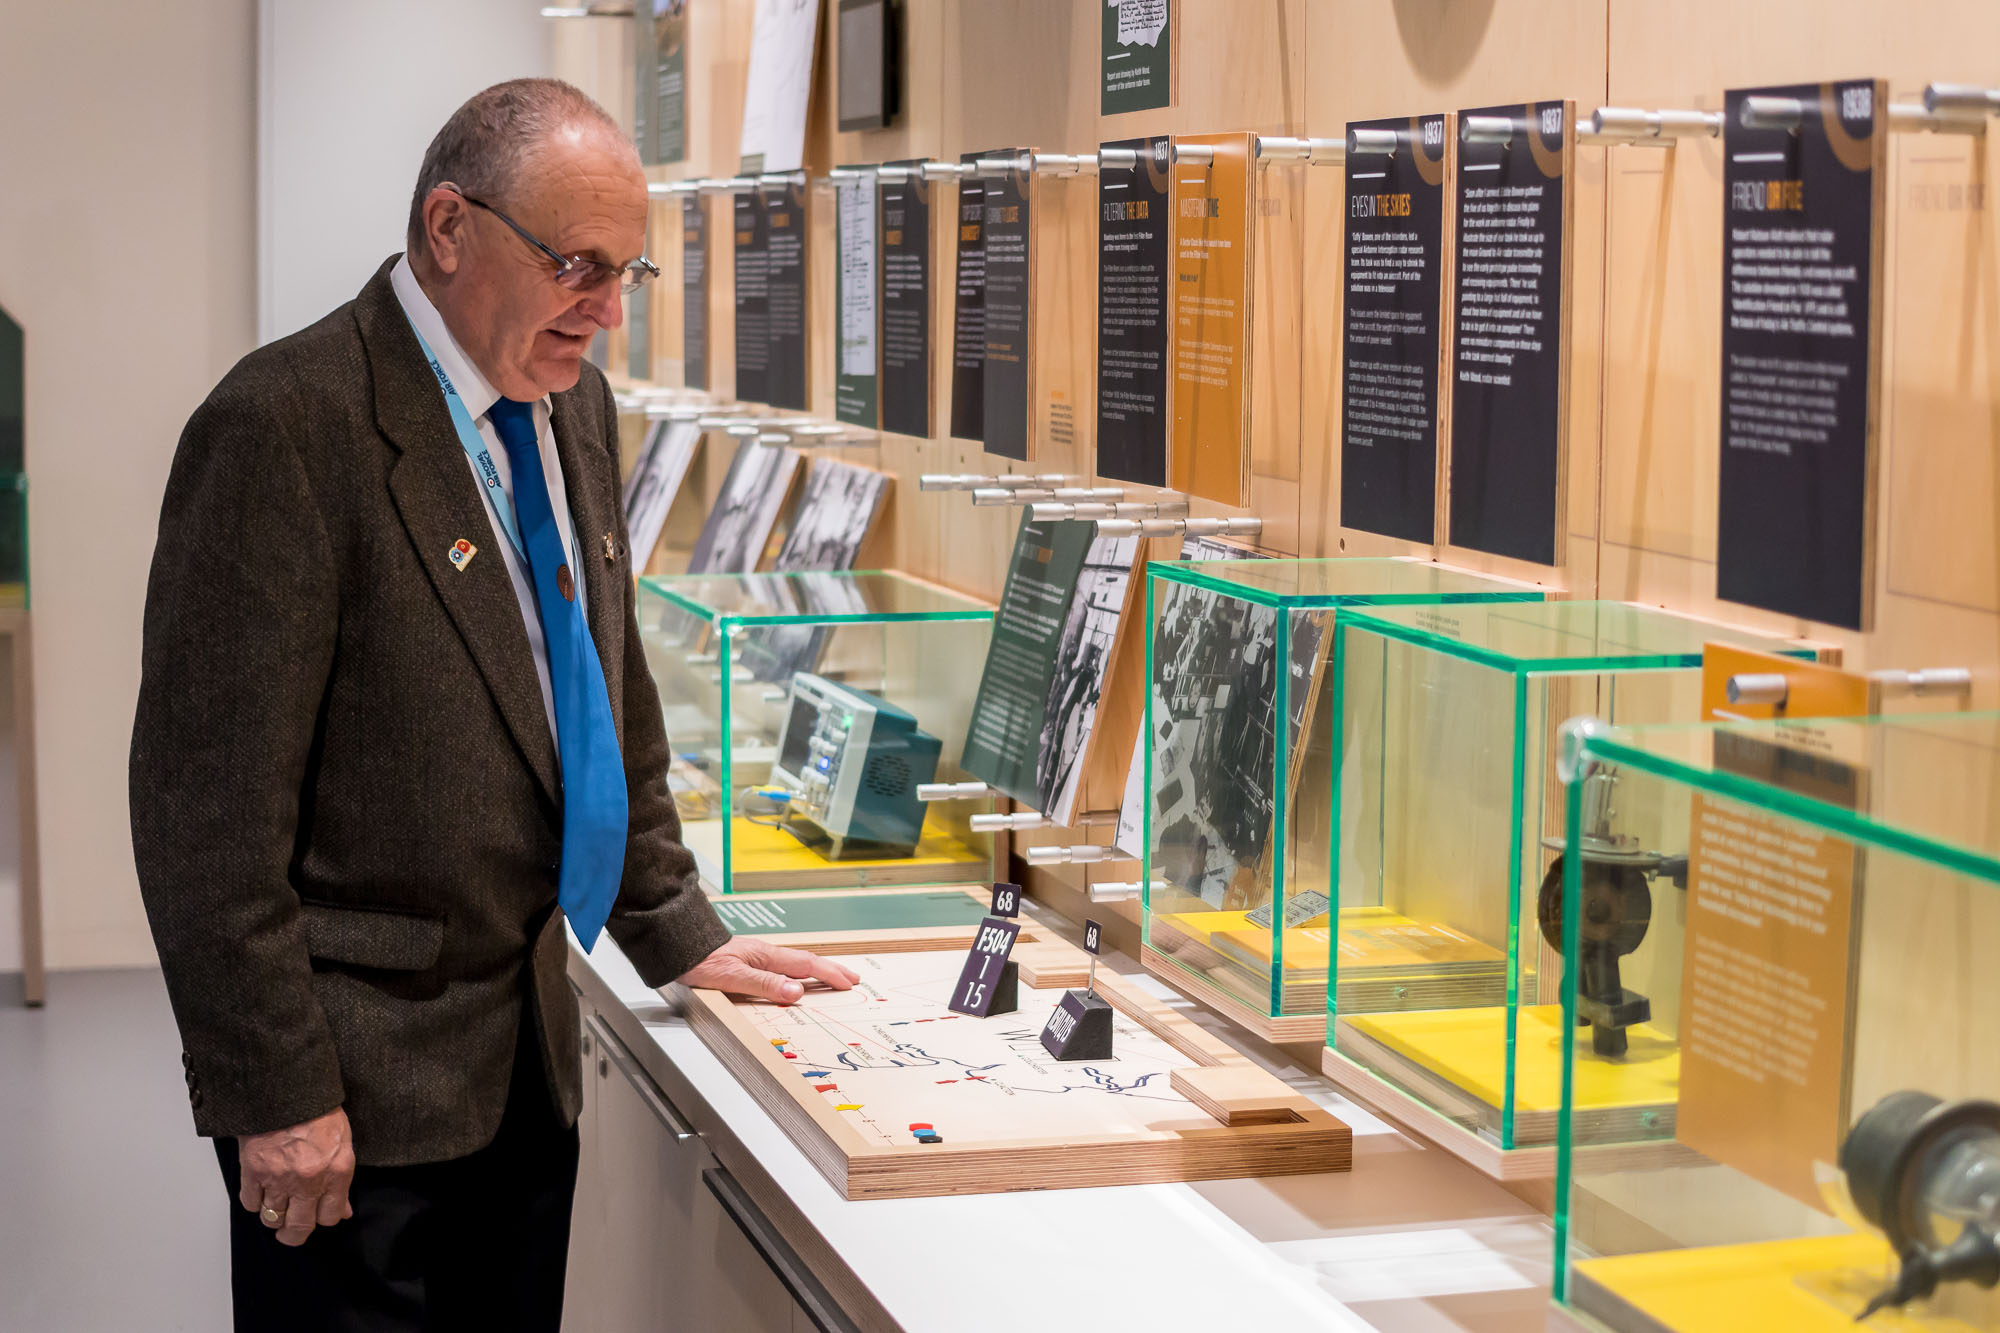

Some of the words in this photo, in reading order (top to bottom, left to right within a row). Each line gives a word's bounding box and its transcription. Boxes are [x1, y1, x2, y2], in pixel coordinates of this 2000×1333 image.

[1424, 121, 1444, 145] 1937
[1542, 108, 1563, 134] 1937
[1155, 142, 1168, 161] 1937
[1104, 202, 1126, 221] FILTERING
[1126, 201, 1136, 220] THE
[1136, 200, 1149, 220] DATA
[1352, 195, 1369, 218] EYES
[1369, 195, 1376, 217] IN
[1376, 194, 1390, 216] THE
[1390, 193, 1412, 216] SKIES
[431, 360, 448, 383] FORCE
[445, 383, 457, 395] AIR
[477, 453, 491, 477] ROYAL
[482, 449, 496, 474] FORCE
[494, 474, 503, 488] AIR
[996, 890, 1014, 912] 68
[976, 926, 1013, 956] F504
[1086, 926, 1098, 949] 68
[979, 955, 991, 980] 1
[963, 982, 986, 1008] 15
